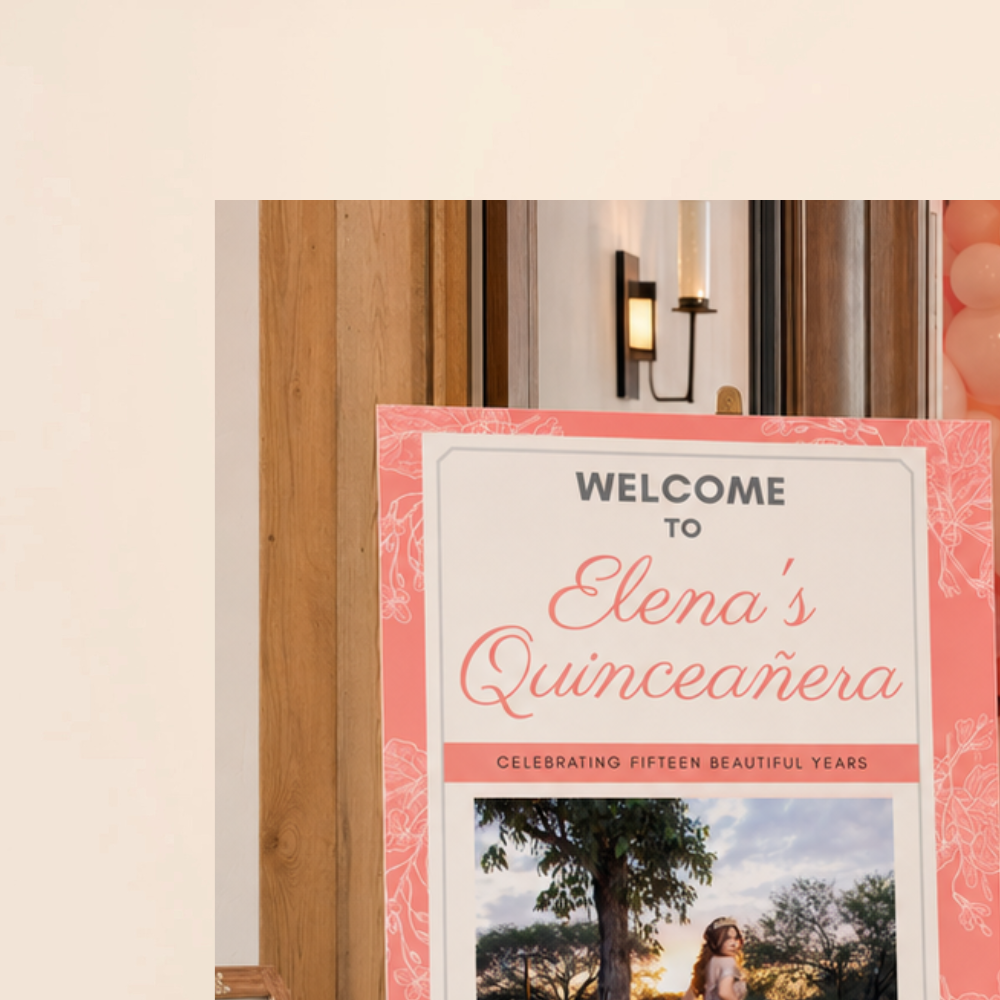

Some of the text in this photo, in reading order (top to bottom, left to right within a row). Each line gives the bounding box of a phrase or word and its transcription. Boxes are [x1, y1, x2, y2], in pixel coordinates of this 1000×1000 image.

[576, 472, 785, 505] WELCOME
[664, 518, 701, 538] TO
[548, 555, 816, 630] Elena's
[460, 623, 903, 719] Quinceañera
[497, 756, 867, 769] CELEBRATING FIFTEEN BEAUTIFUL YEARS
